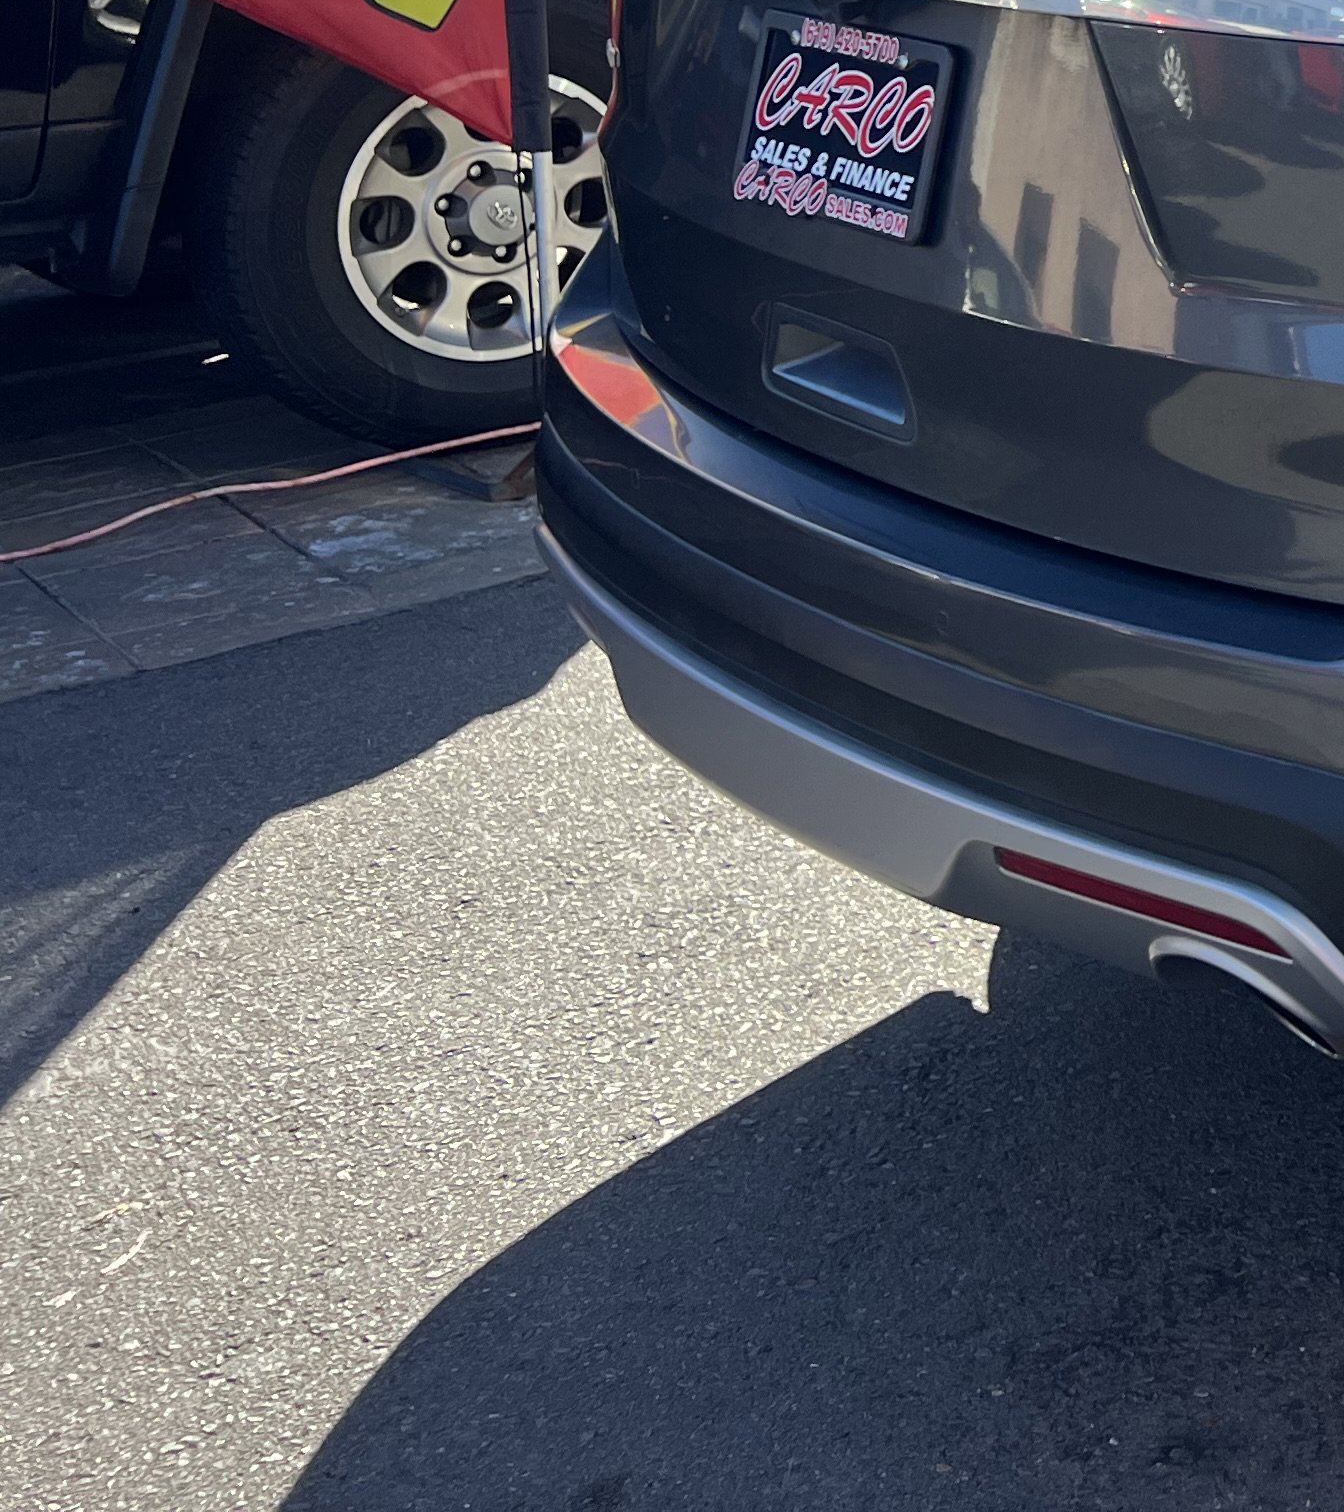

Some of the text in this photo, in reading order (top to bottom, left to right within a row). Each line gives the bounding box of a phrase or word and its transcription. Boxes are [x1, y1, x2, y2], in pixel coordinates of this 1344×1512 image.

[801, 17, 900, 65] (619) 420-5700
[756, 52, 935, 158] CARCO
[734, 159, 828, 216] CARCO
[751, 136, 915, 201] SALES & FINANCE
